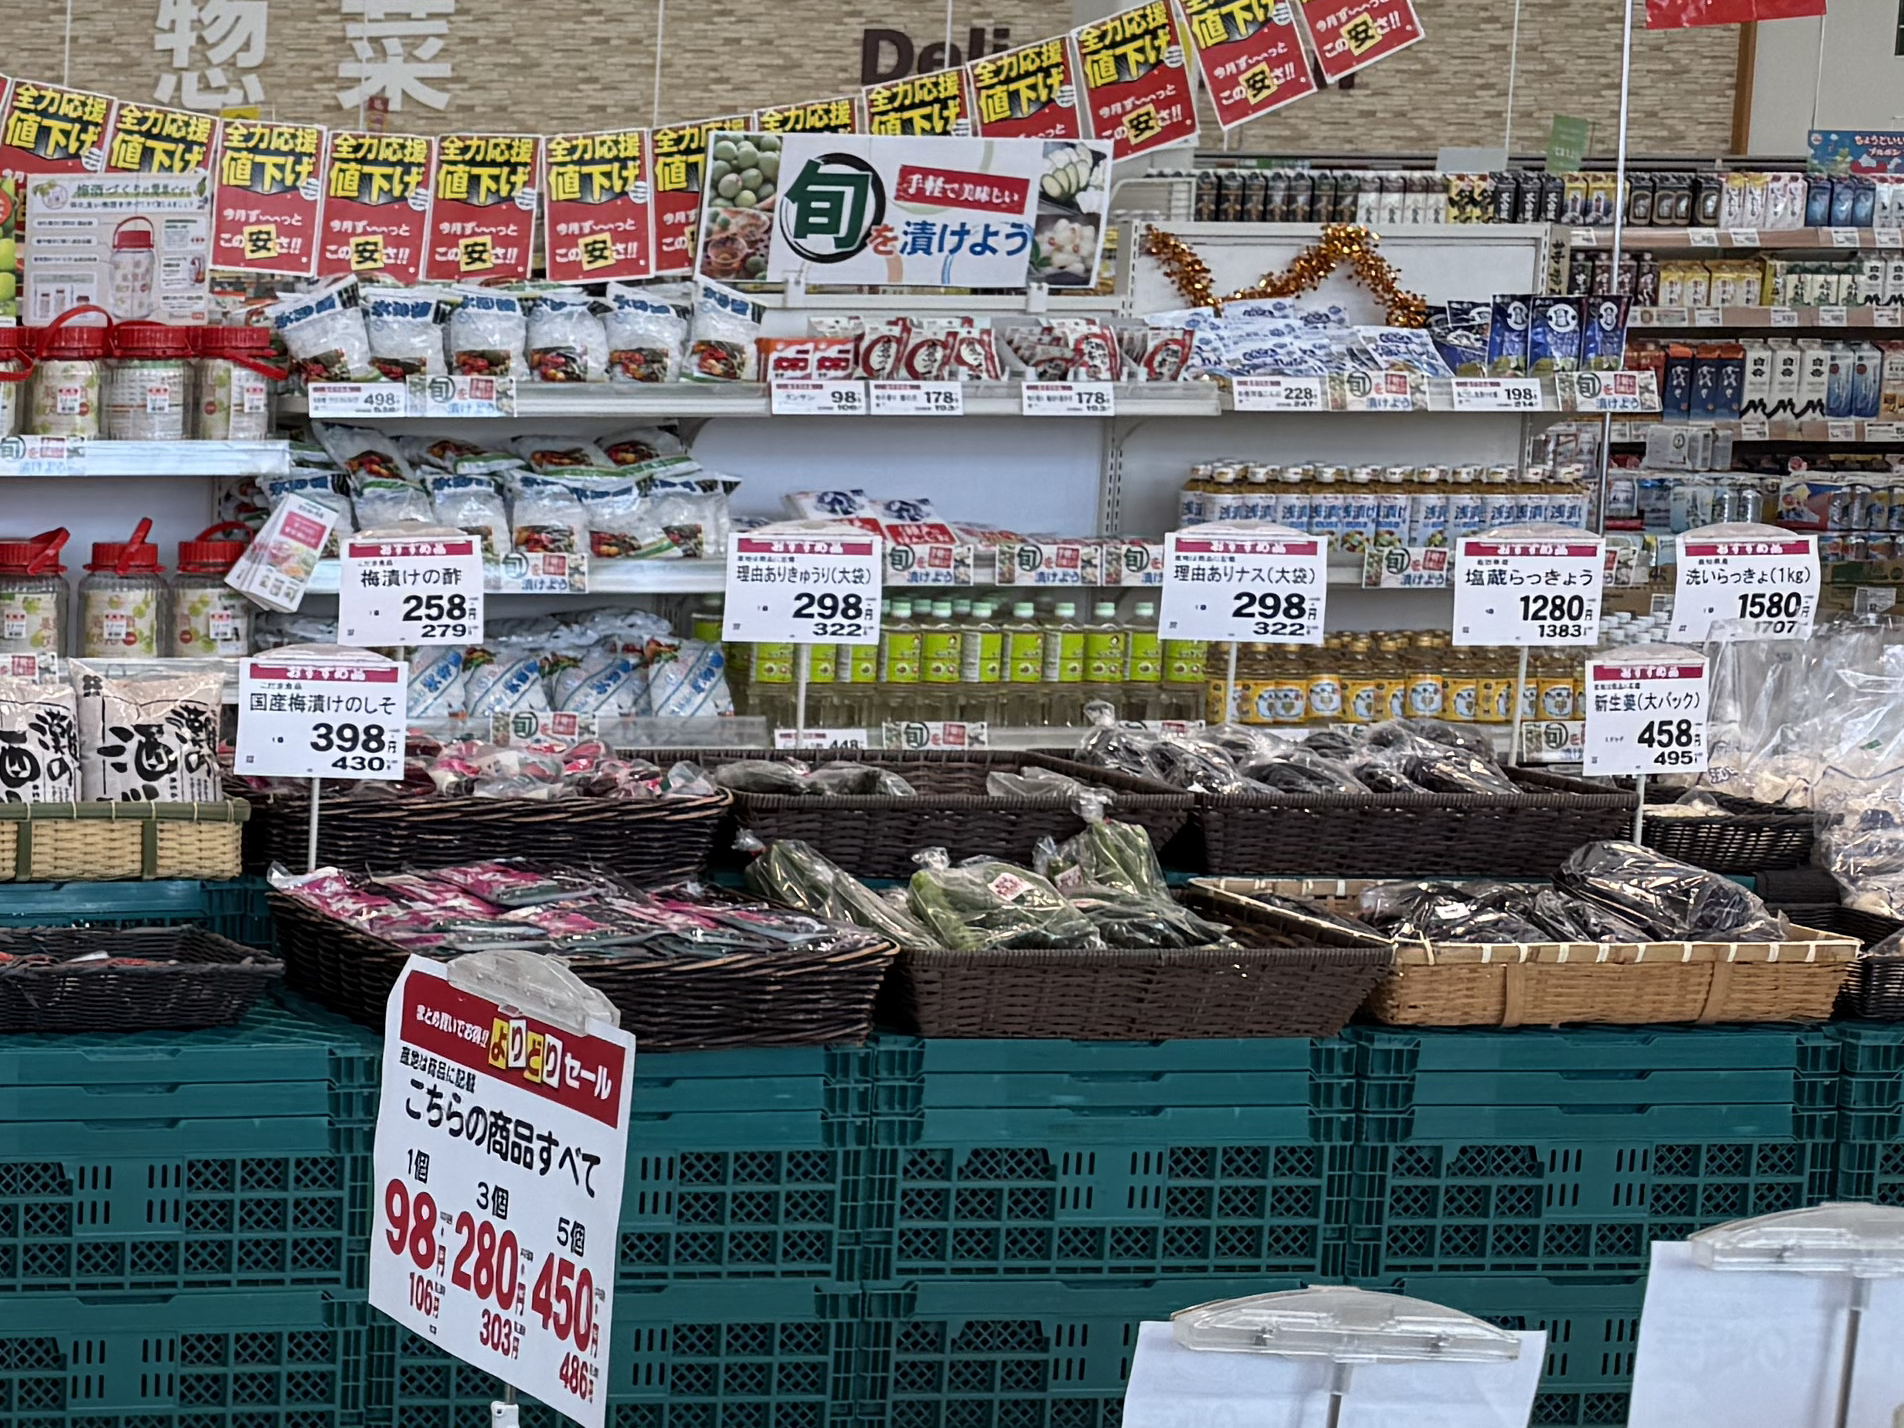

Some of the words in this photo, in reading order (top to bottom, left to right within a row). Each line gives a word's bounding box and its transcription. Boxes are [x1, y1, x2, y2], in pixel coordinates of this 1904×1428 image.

[1078, 2, 1168, 53] 全力応援
[973, 41, 1062, 88] 全力応援
[12, 83, 108, 124] 全力応援
[868, 72, 960, 111] 全力応援
[116, 104, 212, 143] 全力応援
[761, 100, 852, 132] 全力応援
[223, 123, 319, 153] 全力応援
[330, 133, 428, 164] 全力応援
[439, 135, 532, 164] 全力応援
[547, 133, 640, 163] 全力応援
[402, 593, 467, 622] 258
[792, 590, 864, 622] 298
[1231, 590, 1305, 621] 298
[1519, 594, 1586, 621] 1280
[1738, 592, 1801, 619] 1580
[420, 622, 467, 638] 279
[812, 621, 864, 638] 322
[1252, 621, 1305, 638] 322
[310, 722, 386, 754] 398
[1637, 719, 1694, 749] 458
[330, 756, 385, 772] 430
[1653, 750, 1694, 765] 495
[563, 1051, 613, 1100] セール
[405, 1079, 602, 1198] こちらの商品すべて
[406, 1148, 431, 1185] 1個
[476, 1181, 510, 1220] 3個
[385, 1178, 439, 1270] 98
[557, 1217, 587, 1258] 5個
[451, 1211, 519, 1311] 280
[409, 1272, 434, 1317] 106
[531, 1252, 594, 1352] 450
[479, 1308, 514, 1356] 303
[559, 1353, 590, 1401] 486
